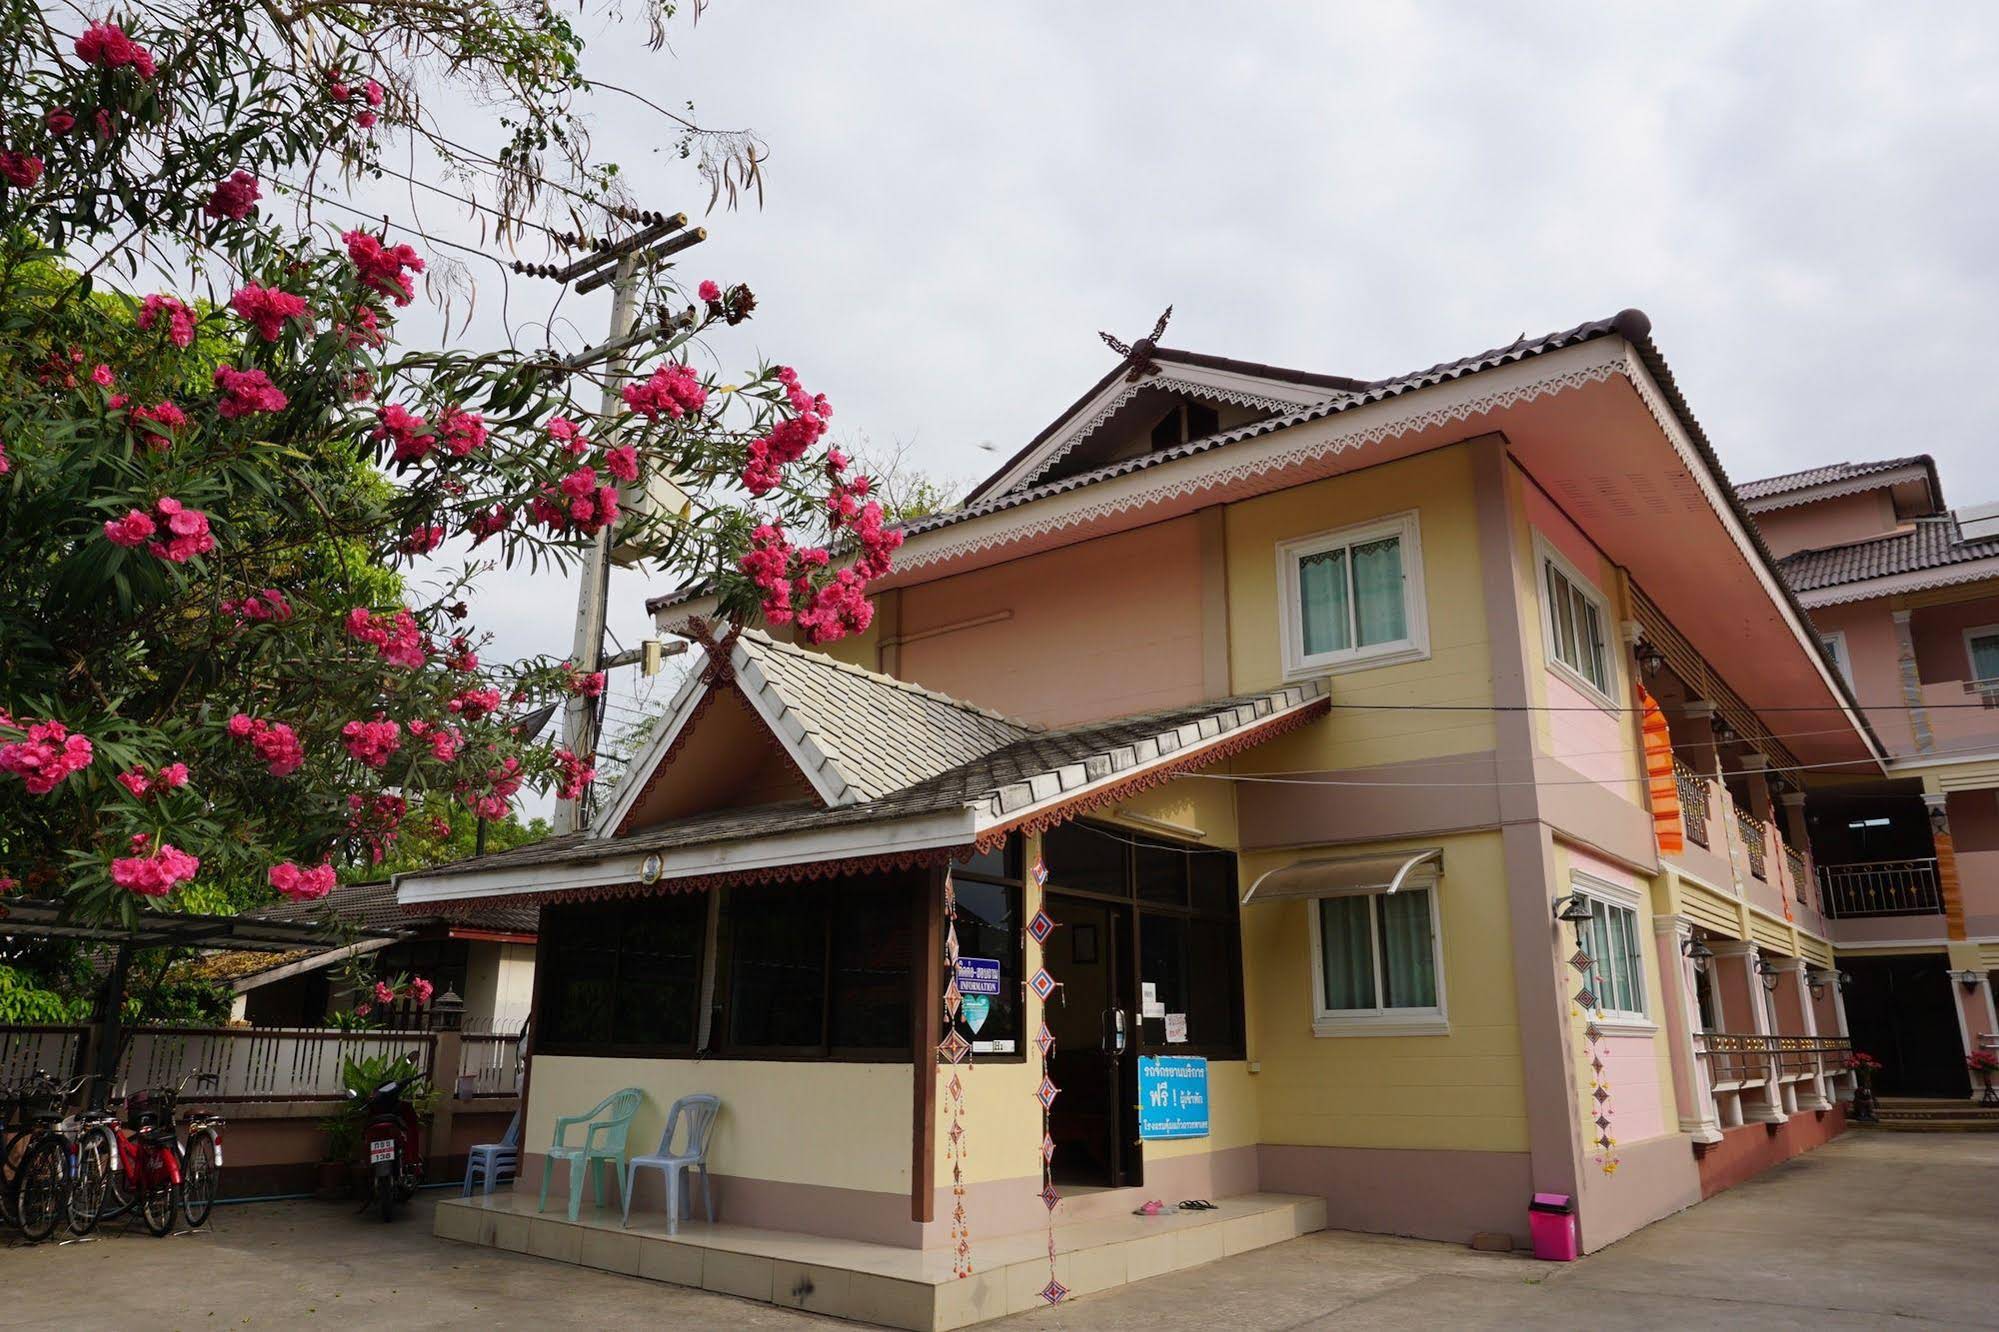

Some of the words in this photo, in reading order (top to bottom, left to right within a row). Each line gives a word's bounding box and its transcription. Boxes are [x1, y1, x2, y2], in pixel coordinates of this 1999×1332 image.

[960, 981, 996, 991] INFORMATION
[1144, 1062, 1204, 1078] รถจักรยานบริการ
[1150, 1081, 1168, 1107] ฟรี
[1172, 1088, 1177, 1107] !
